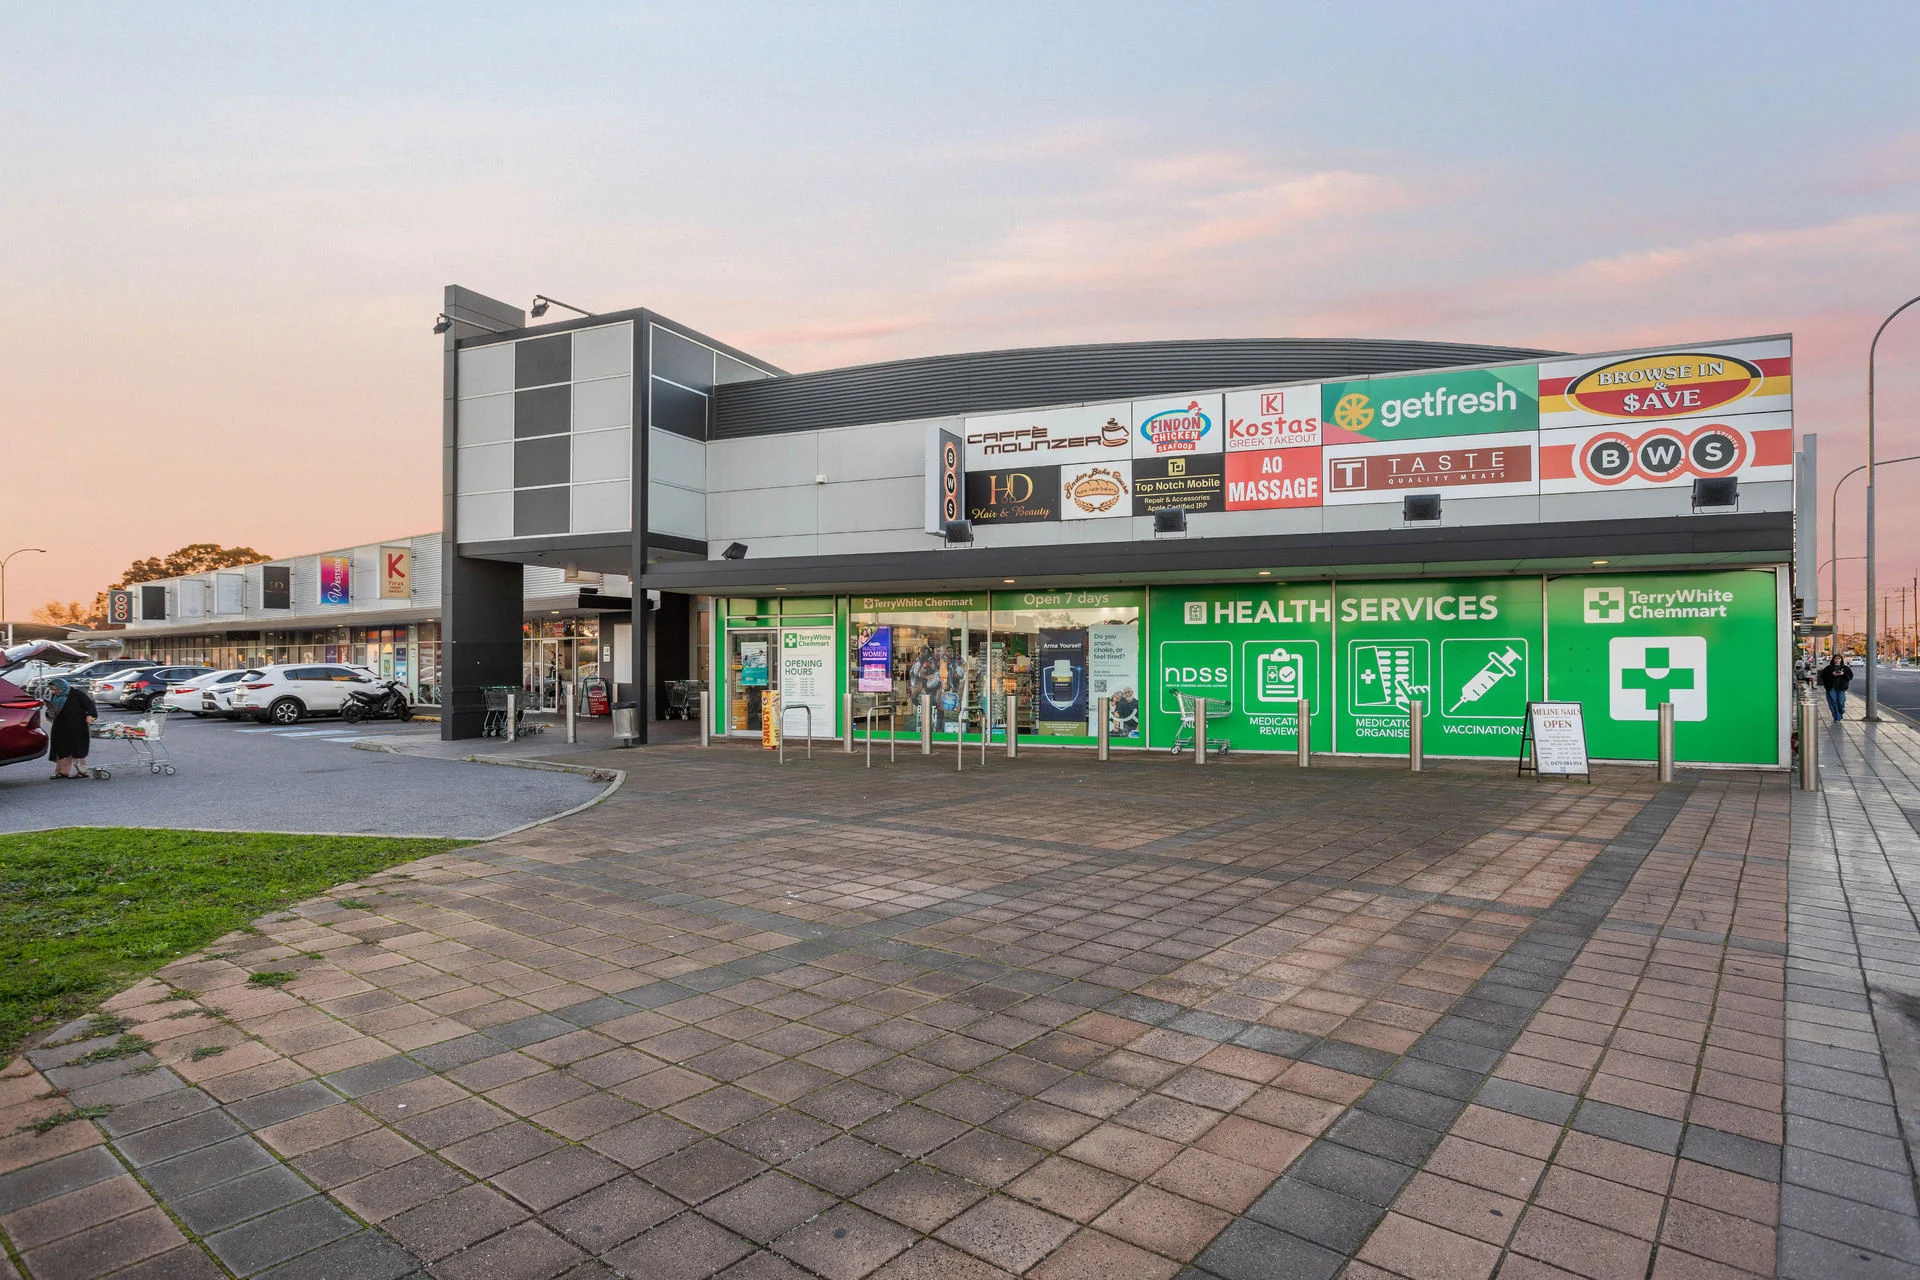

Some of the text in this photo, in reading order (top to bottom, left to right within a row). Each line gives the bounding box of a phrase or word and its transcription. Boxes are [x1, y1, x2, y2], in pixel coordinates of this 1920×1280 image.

[1598, 361, 1724, 387] BROWSE IN
[1653, 381, 1669, 391] &
[1265, 395, 1279, 413] K
[1380, 382, 1517, 427] getfresh
[1622, 388, 1701, 414] $AVE
[1151, 417, 1201, 433] FINDON
[1229, 416, 1317, 439] Kostas
[967, 426, 1048, 445] CAFFÈ
[1152, 431, 1198, 443] CHICKEN
[1229, 433, 1317, 448] GREEK TAKEOUT
[1158, 443, 1193, 452] SEAFOOD
[1262, 456, 1283, 474] AO
[1388, 451, 1505, 474] TASTE
[1336, 462, 1362, 487] T
[1388, 472, 1505, 485] QUALITY MEATS
[1135, 478, 1220, 492] Top Notch Mobile
[1228, 477, 1318, 503] MASSAGE
[1144, 496, 1165, 505] Repair
[1172, 494, 1211, 502] Accessories
[971, 505, 1051, 519] Hair & Beauty
[388, 553, 406, 579] K
[874, 597, 973, 609] TerryWhite Chemmart
[1023, 591, 1109, 608] Open 7 days
[1628, 588, 1734, 607] TerryWhite
[1214, 595, 1498, 624] HEALTH SERVICES
[1628, 604, 1727, 619] Chemmart
[784, 659, 823, 668] OPENING
[784, 667, 813, 676] HOURS
[1560, 708, 1582, 716] NAILS
[1249, 717, 1312, 726] MEDICATI
[1543, 719, 1572, 728] OPEN
[1442, 725, 1525, 735] VACCINATIONS
